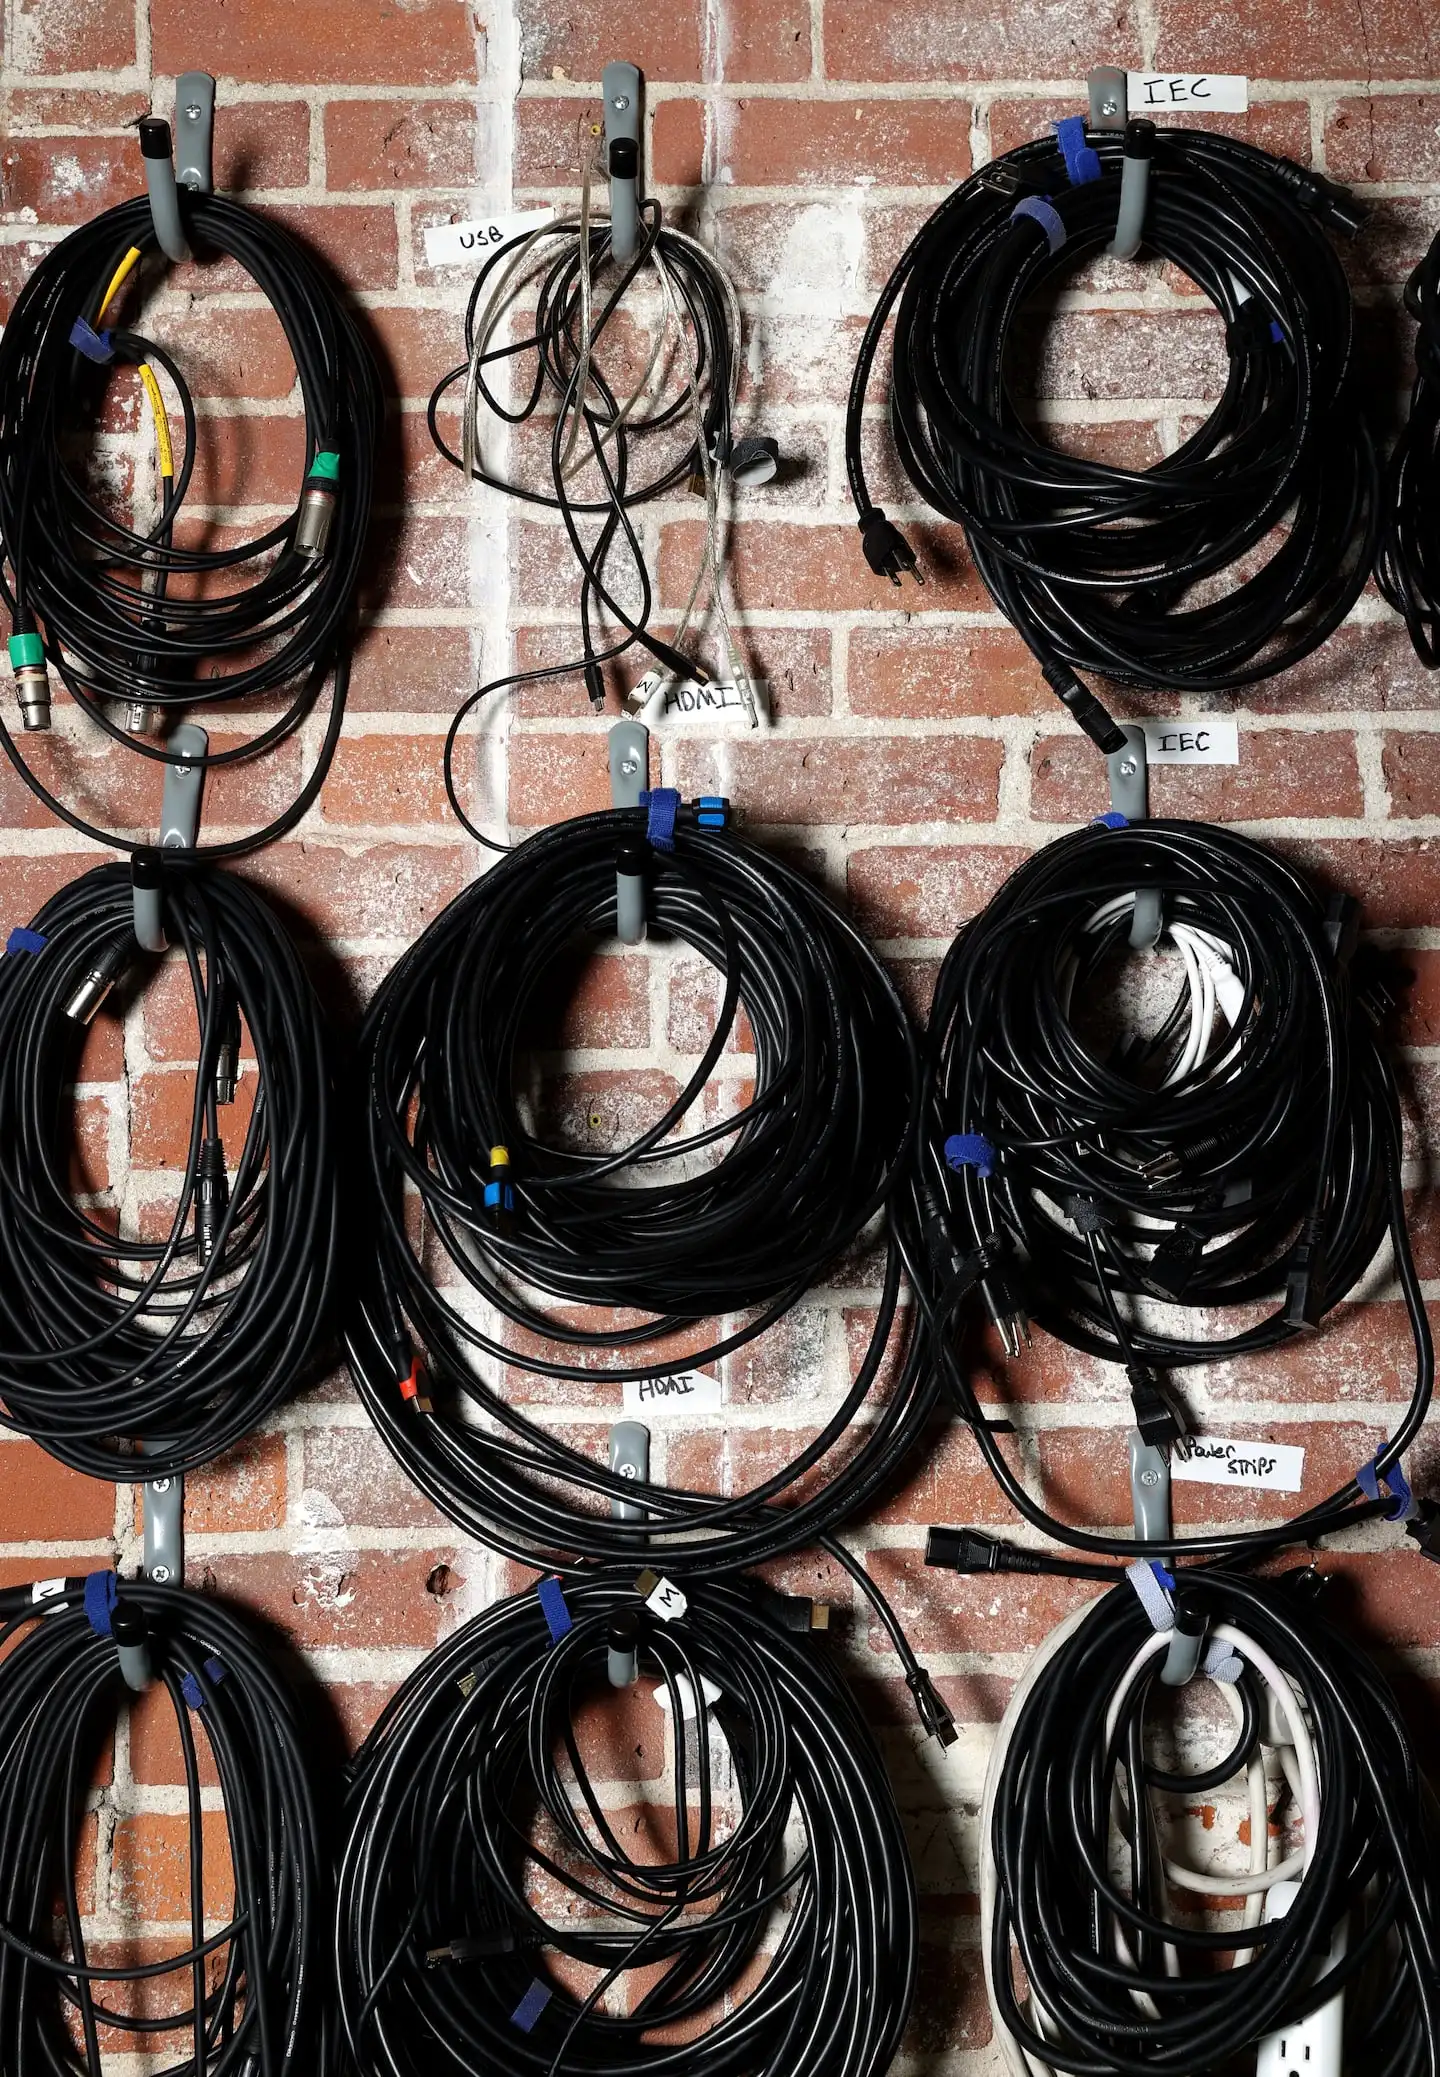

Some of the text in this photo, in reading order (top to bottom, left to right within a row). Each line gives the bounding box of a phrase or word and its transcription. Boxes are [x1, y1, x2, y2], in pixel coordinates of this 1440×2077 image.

[1143, 78, 1212, 104] IEC
[459, 225, 504, 249] USB
[664, 686, 742, 715] HDMI
[1157, 731, 1211, 752] IEC
[639, 1376, 695, 1402] HDMI
[658, 1587, 680, 1608] M
